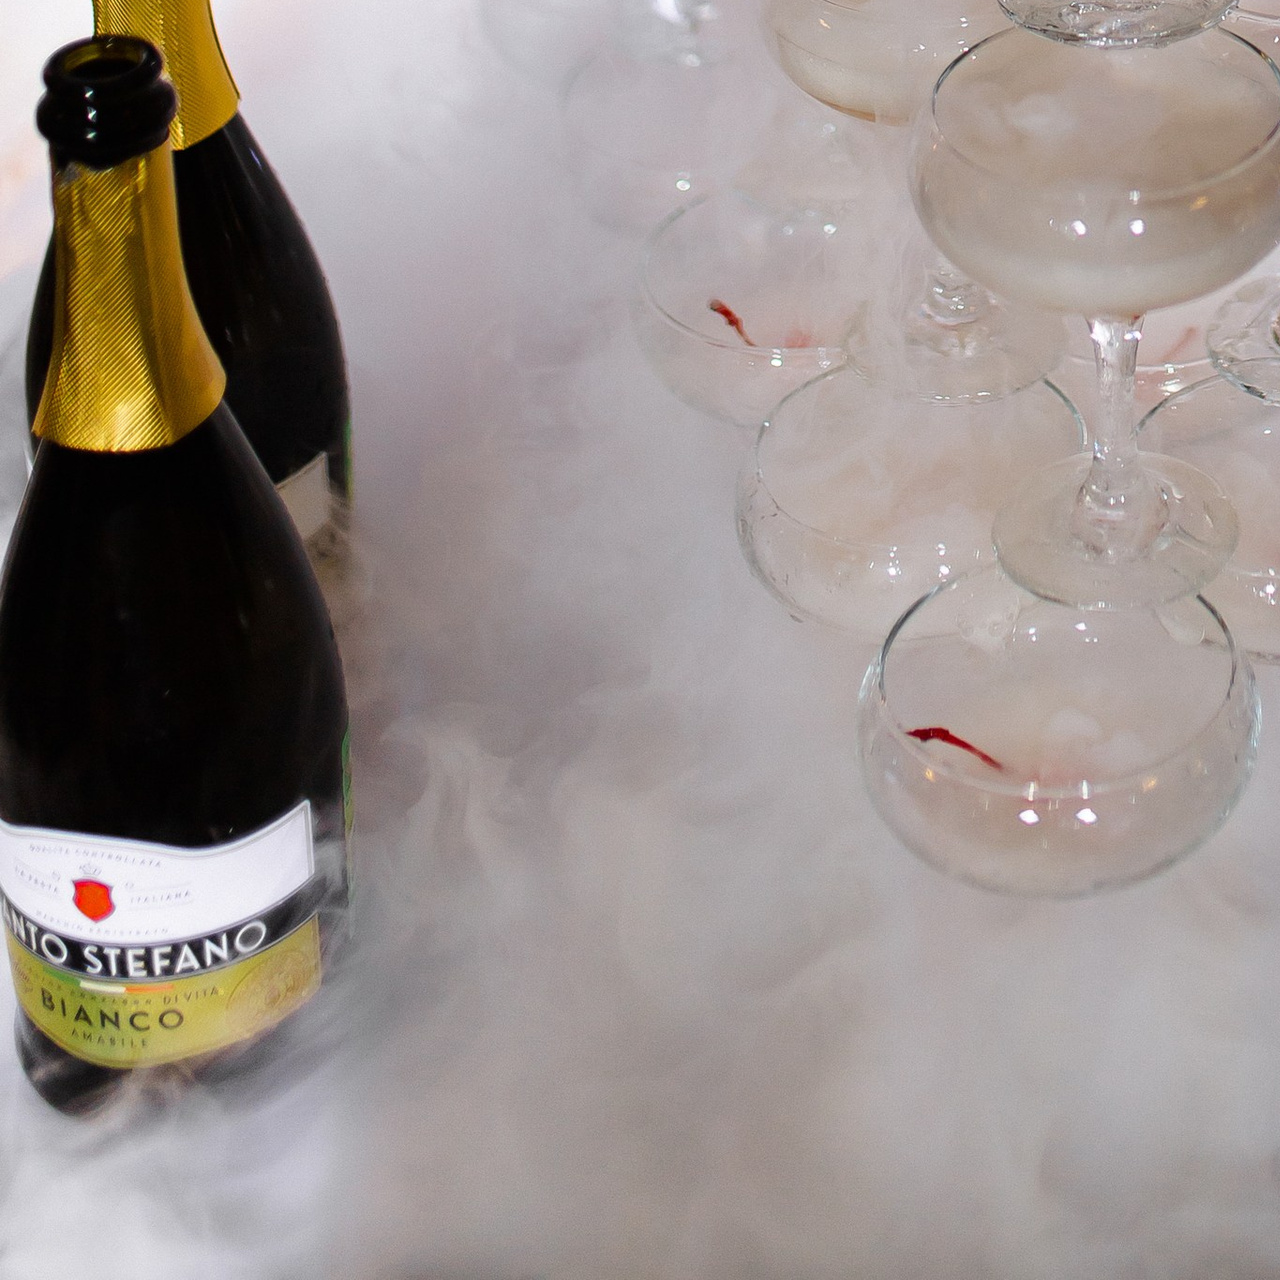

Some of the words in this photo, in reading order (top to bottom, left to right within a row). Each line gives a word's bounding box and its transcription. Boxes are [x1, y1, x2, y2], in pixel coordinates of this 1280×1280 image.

[83, 920, 267, 978] STEFANO
[41, 986, 185, 1032] BIANCO
[70, 1027, 150, 1049] AMABILE
